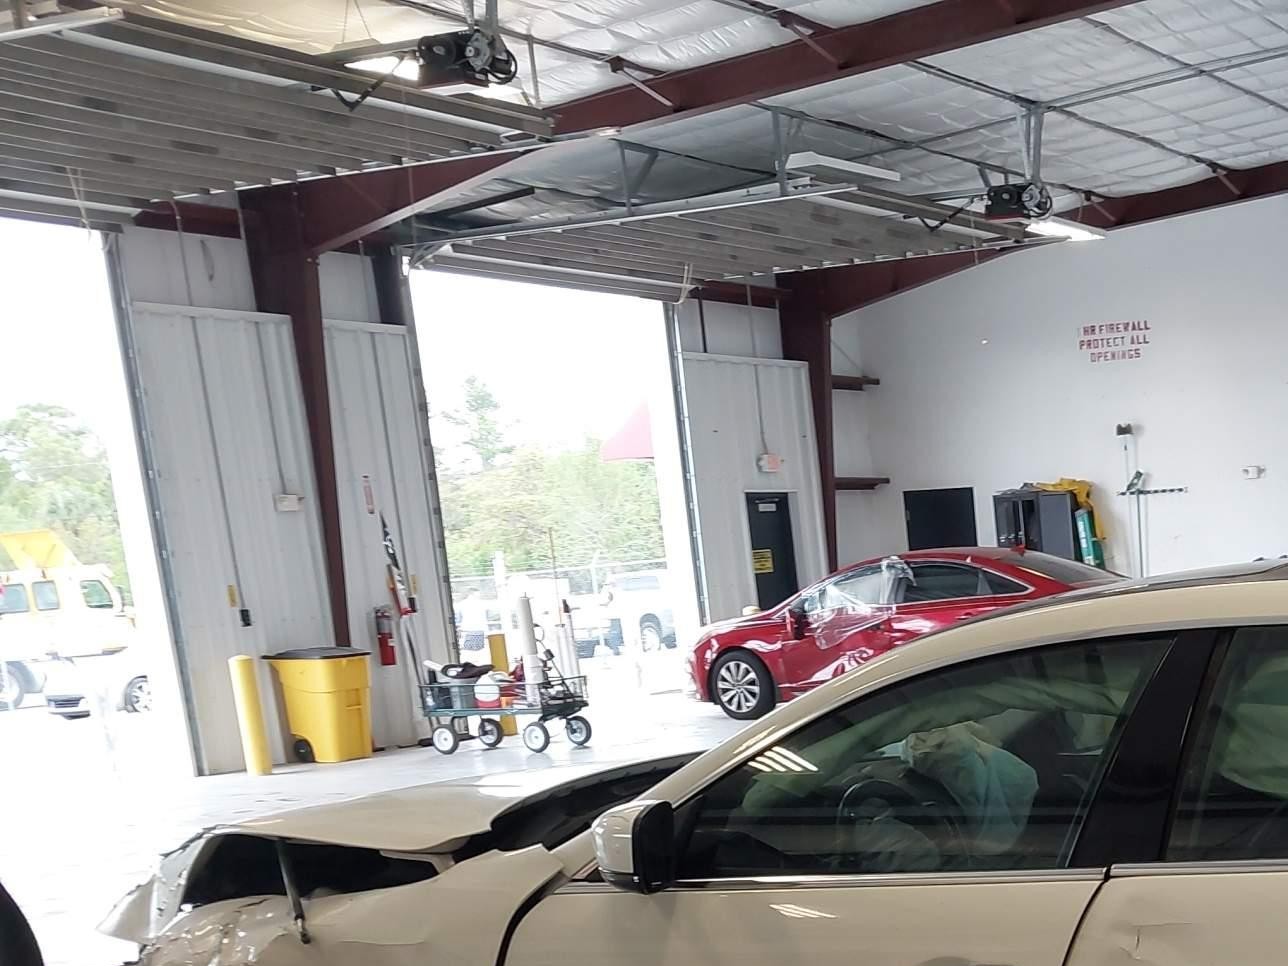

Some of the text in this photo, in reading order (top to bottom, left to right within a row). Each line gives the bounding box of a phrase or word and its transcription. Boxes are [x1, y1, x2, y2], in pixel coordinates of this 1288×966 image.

[1082, 319, 1151, 337] HR FIREWALL
[1078, 334, 1150, 351] PROTECT ALL
[1089, 348, 1141, 363] OPENINGS
